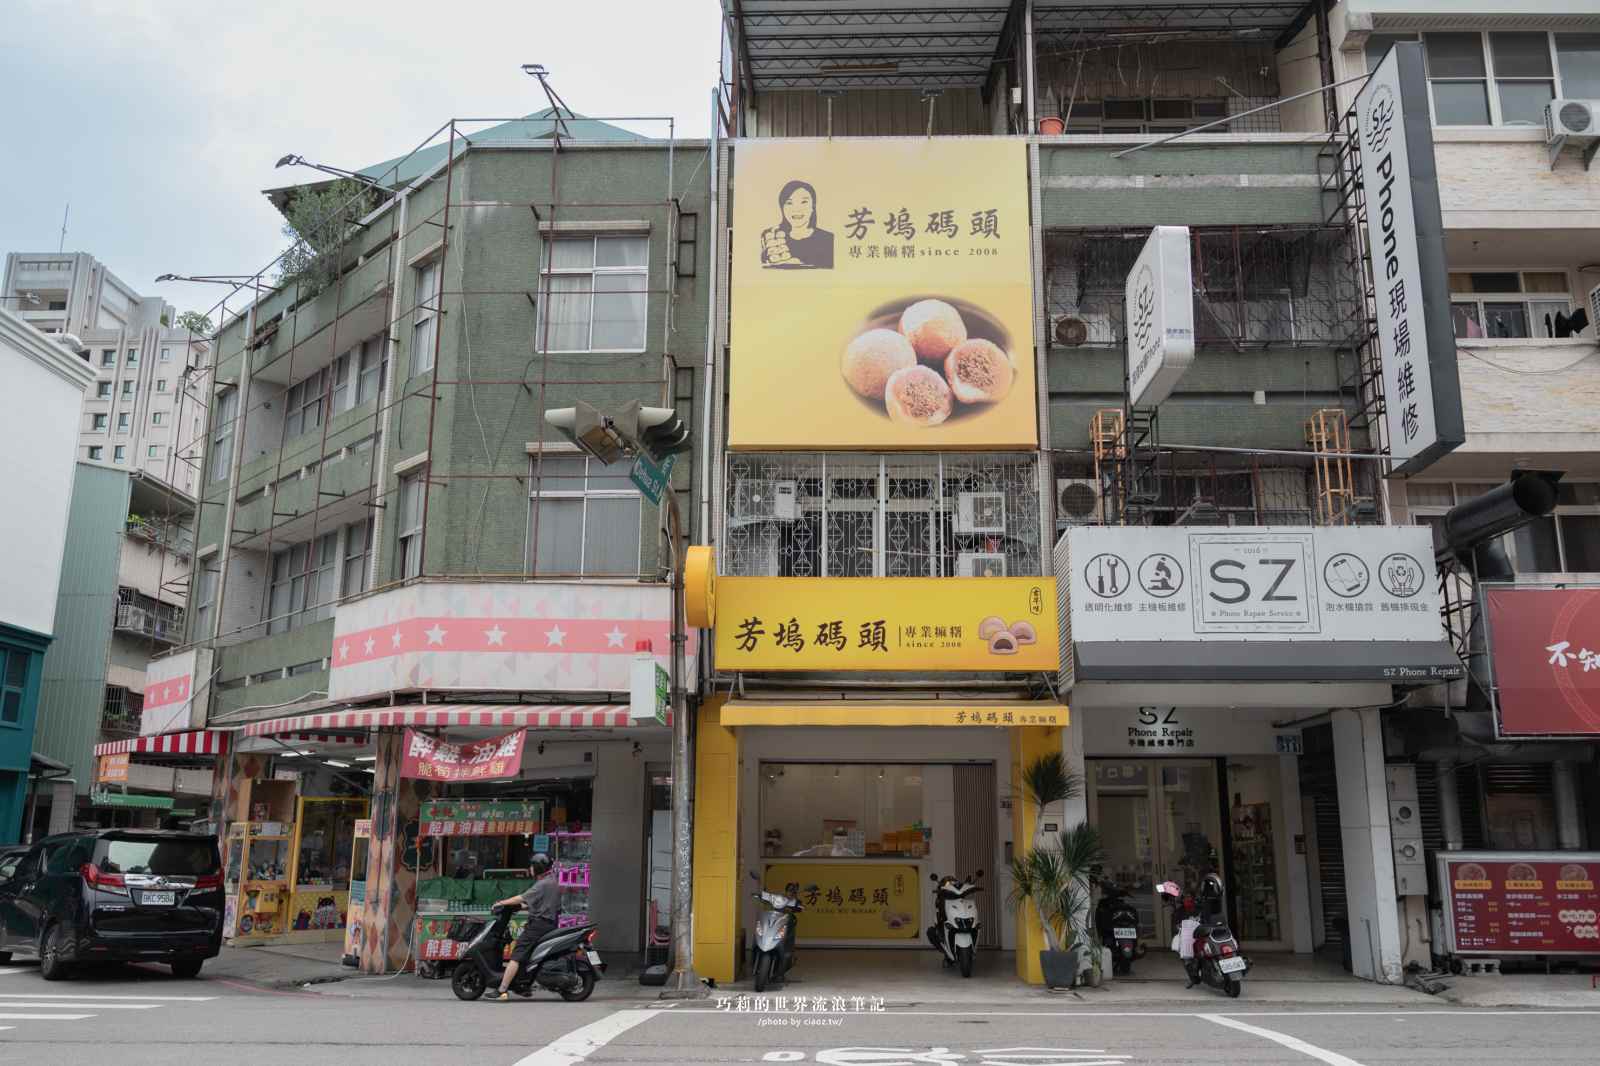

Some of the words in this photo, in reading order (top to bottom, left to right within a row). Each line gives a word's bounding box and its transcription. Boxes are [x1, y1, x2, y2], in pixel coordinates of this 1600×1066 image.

[844, 207, 1001, 241] 芳塢碼頭
[1375, 151, 1399, 281] Phone
[919, 247, 960, 256] since
[968, 248, 998, 256] 2008
[1389, 279, 1420, 445] 現場維修
[1208, 559, 1298, 605] SZ
[734, 617, 889, 653] 芳塢碼頭
[1384, 668, 1397, 677] SZ
[1399, 667, 1426, 677] Phone
[1430, 667, 1460, 679] Repair
[955, 710, 1014, 724] 芳塢碼頭
[1128, 727, 1157, 737] Phone
[1162, 727, 1193, 739] Repair
